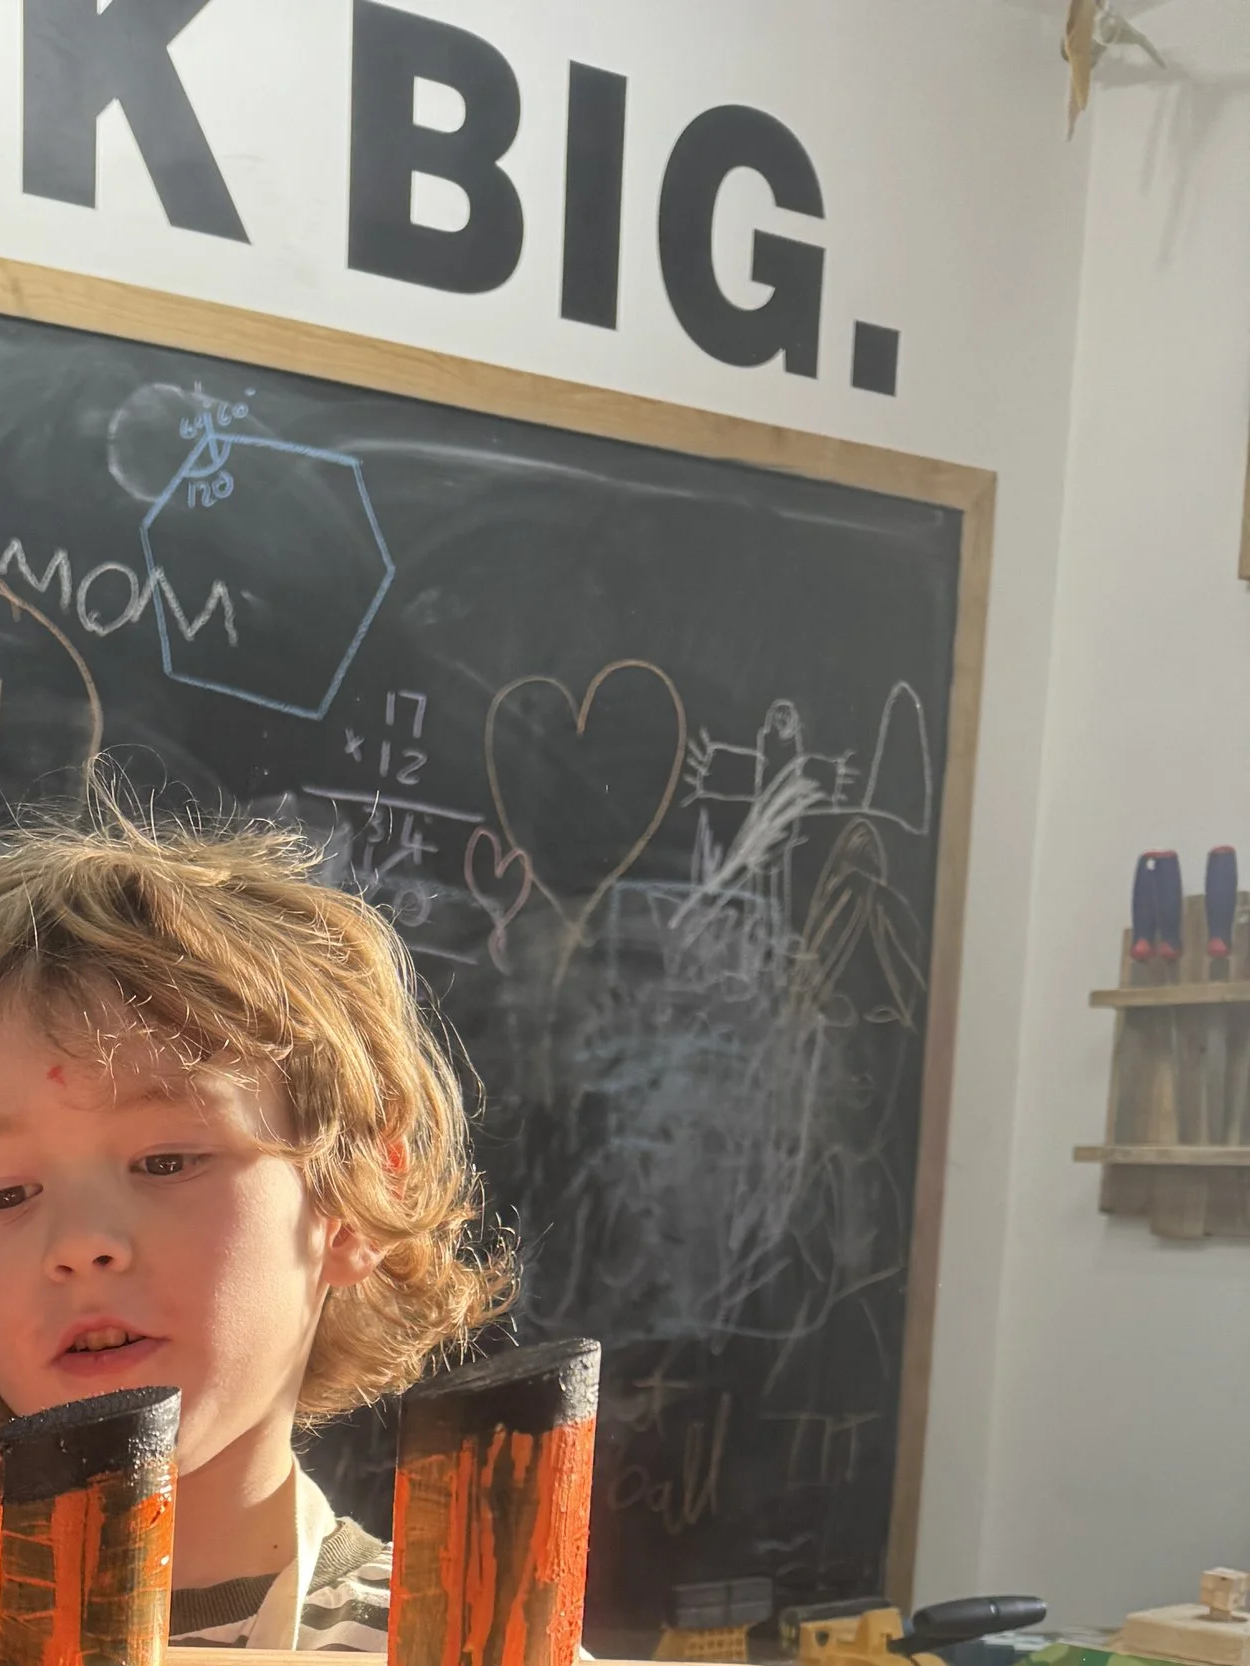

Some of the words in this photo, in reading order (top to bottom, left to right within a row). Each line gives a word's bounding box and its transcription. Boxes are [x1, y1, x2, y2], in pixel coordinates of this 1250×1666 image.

[348, 0, 900, 397] BIG.
[187, 470, 235, 509] 120
[384, 689, 428, 739] 17
[378, 739, 429, 786] 12
